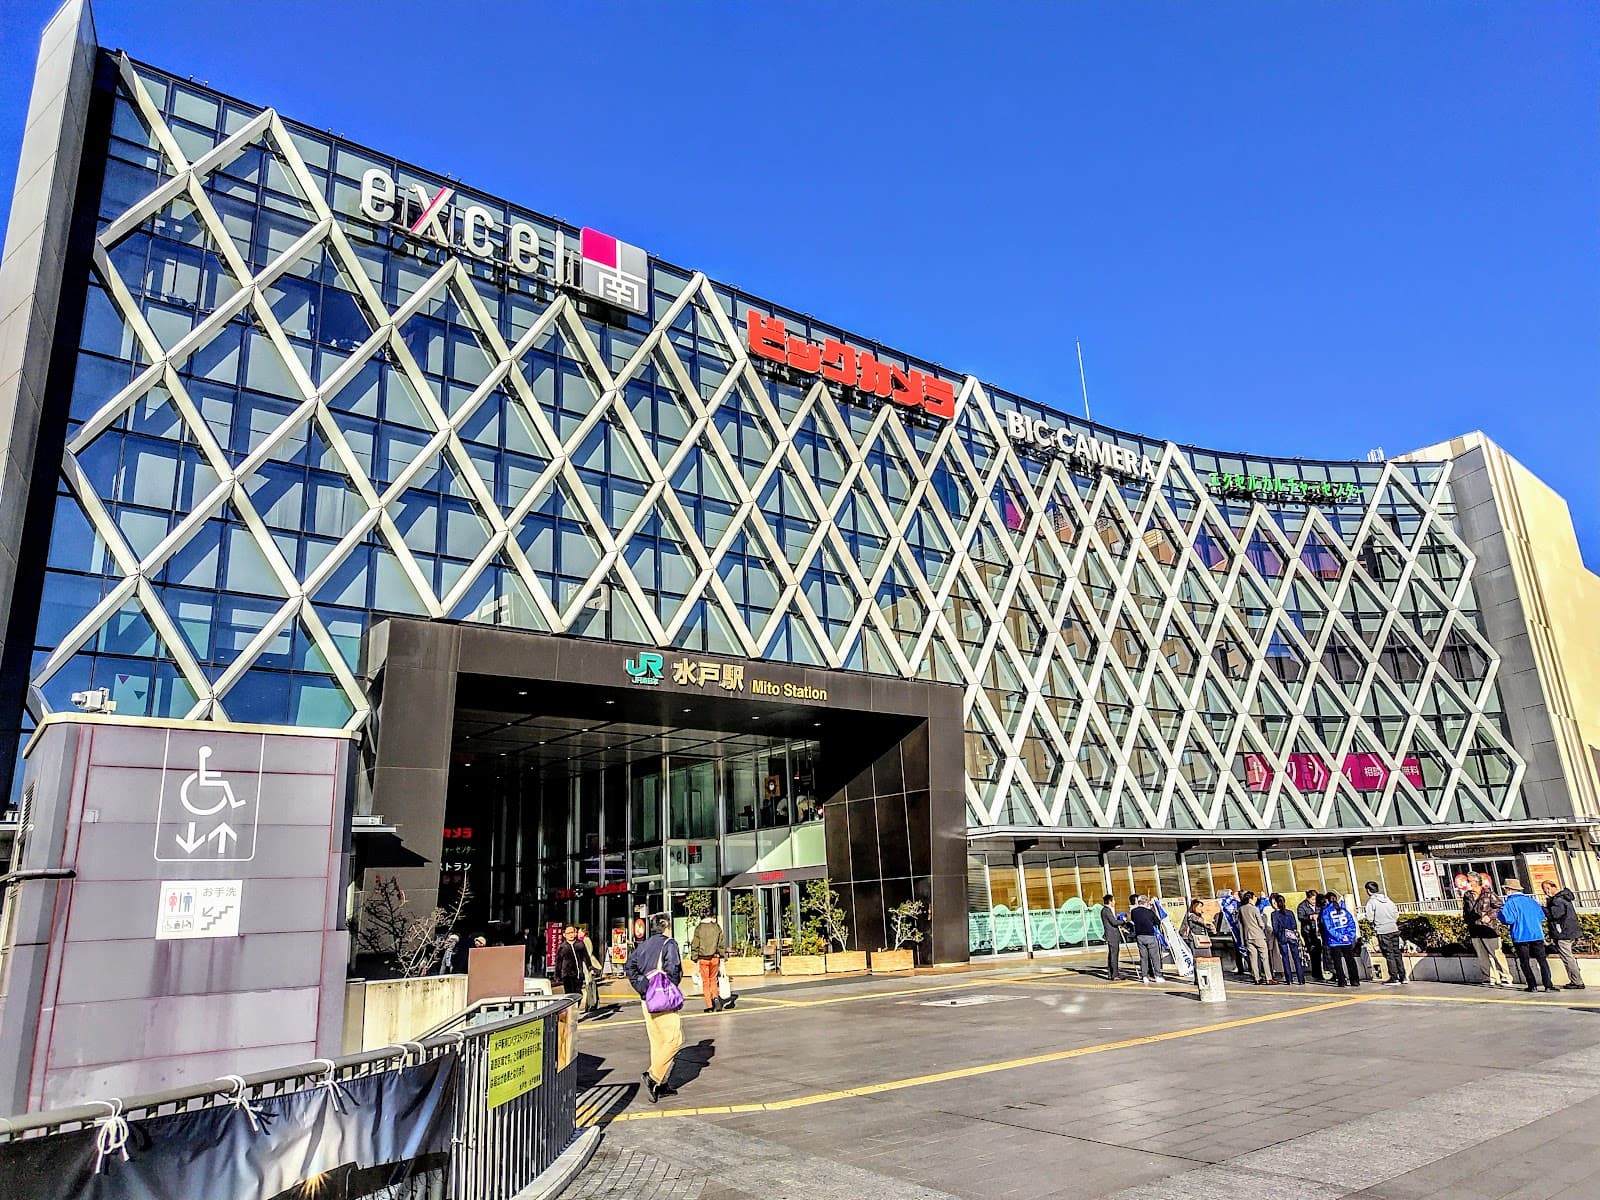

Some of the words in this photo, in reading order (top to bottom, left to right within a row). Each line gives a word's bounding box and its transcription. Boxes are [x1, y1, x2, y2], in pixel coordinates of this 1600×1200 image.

[361, 168, 564, 288] excel
[747, 309, 955, 419] ビックカメラ
[1006, 410, 1051, 448] BIC
[1056, 427, 1156, 482] CAMERA
[1209, 473, 1364, 497] エクセルカルチャーセンター
[626, 652, 664, 679] JR
[672, 658, 745, 691] 水戸駅
[752, 680, 781, 696] Mito
[783, 683, 828, 701] Station
[203, 886, 237, 898] お手洗
